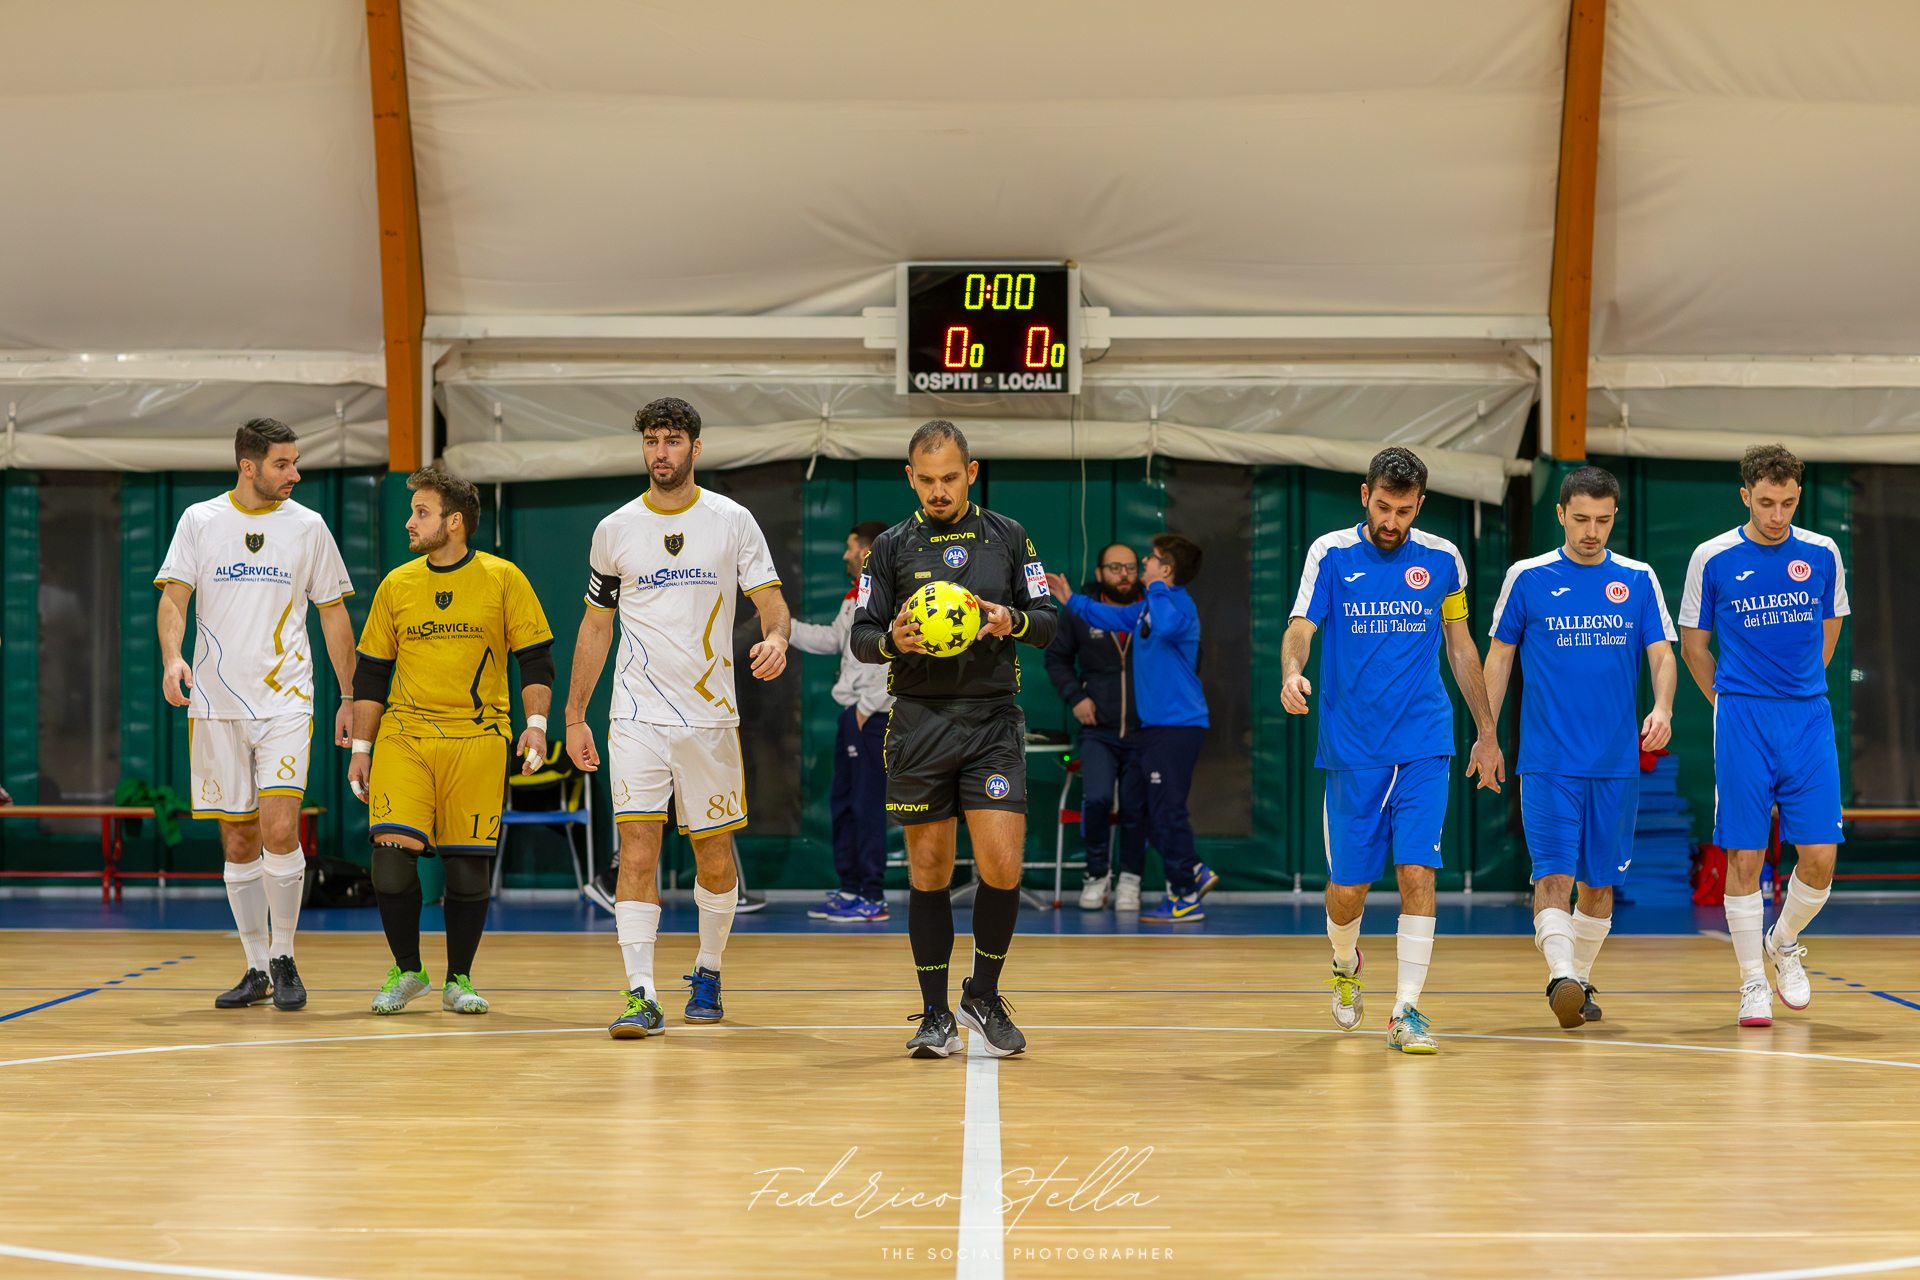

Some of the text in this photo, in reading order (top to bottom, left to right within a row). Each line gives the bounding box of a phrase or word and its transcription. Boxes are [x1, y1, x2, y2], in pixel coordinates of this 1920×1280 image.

[964, 274, 1036, 310] 0:00
[944, 326, 984, 368] 0 0
[1025, 326, 1065, 368] 0 0
[914, 372, 978, 390] OSPITI
[998, 372, 1062, 390] LOCALI
[930, 532, 976, 542] GIVOVA
[1343, 601, 1422, 616] TALLEGNO
[1731, 591, 1809, 613] TALLEGNO
[1352, 619, 1426, 633] dei f.lli Talozzi
[1546, 614, 1623, 630] TALLEGNO
[1744, 614, 1760, 628] dei
[1762, 611, 1780, 625] f.lli
[1557, 632, 1627, 647] dei f.lli Talozzi
[276, 755, 296, 780] 8
[706, 790, 739, 820] 80
[886, 804, 929, 812] GIVOVA
[470, 813, 499, 840] 12
